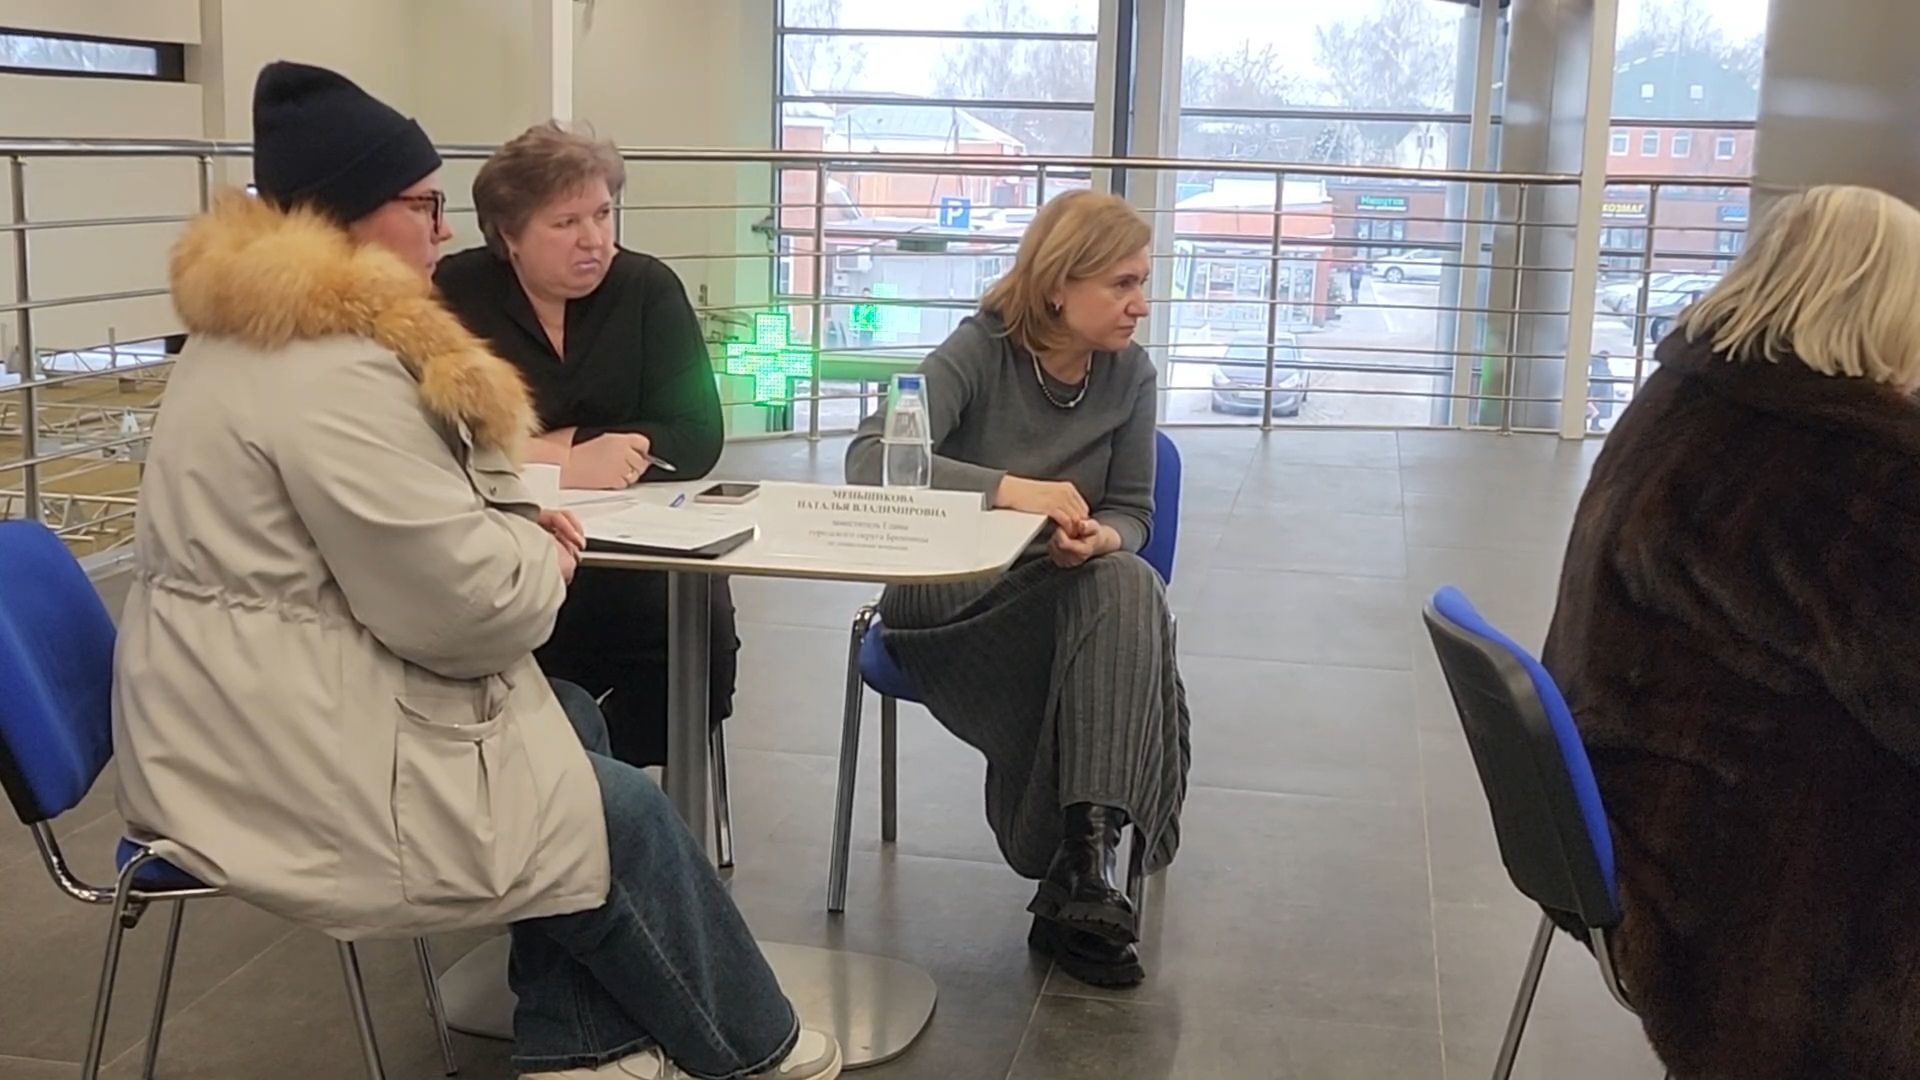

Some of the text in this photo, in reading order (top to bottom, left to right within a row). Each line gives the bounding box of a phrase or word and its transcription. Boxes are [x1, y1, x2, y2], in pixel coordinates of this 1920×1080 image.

[946, 200, 964, 225] P
[832, 490, 915, 504] МЕНЬШИКОВА
[797, 500, 947, 518] НАТАЛЬЯ ВЛАДИМИРОВНА
